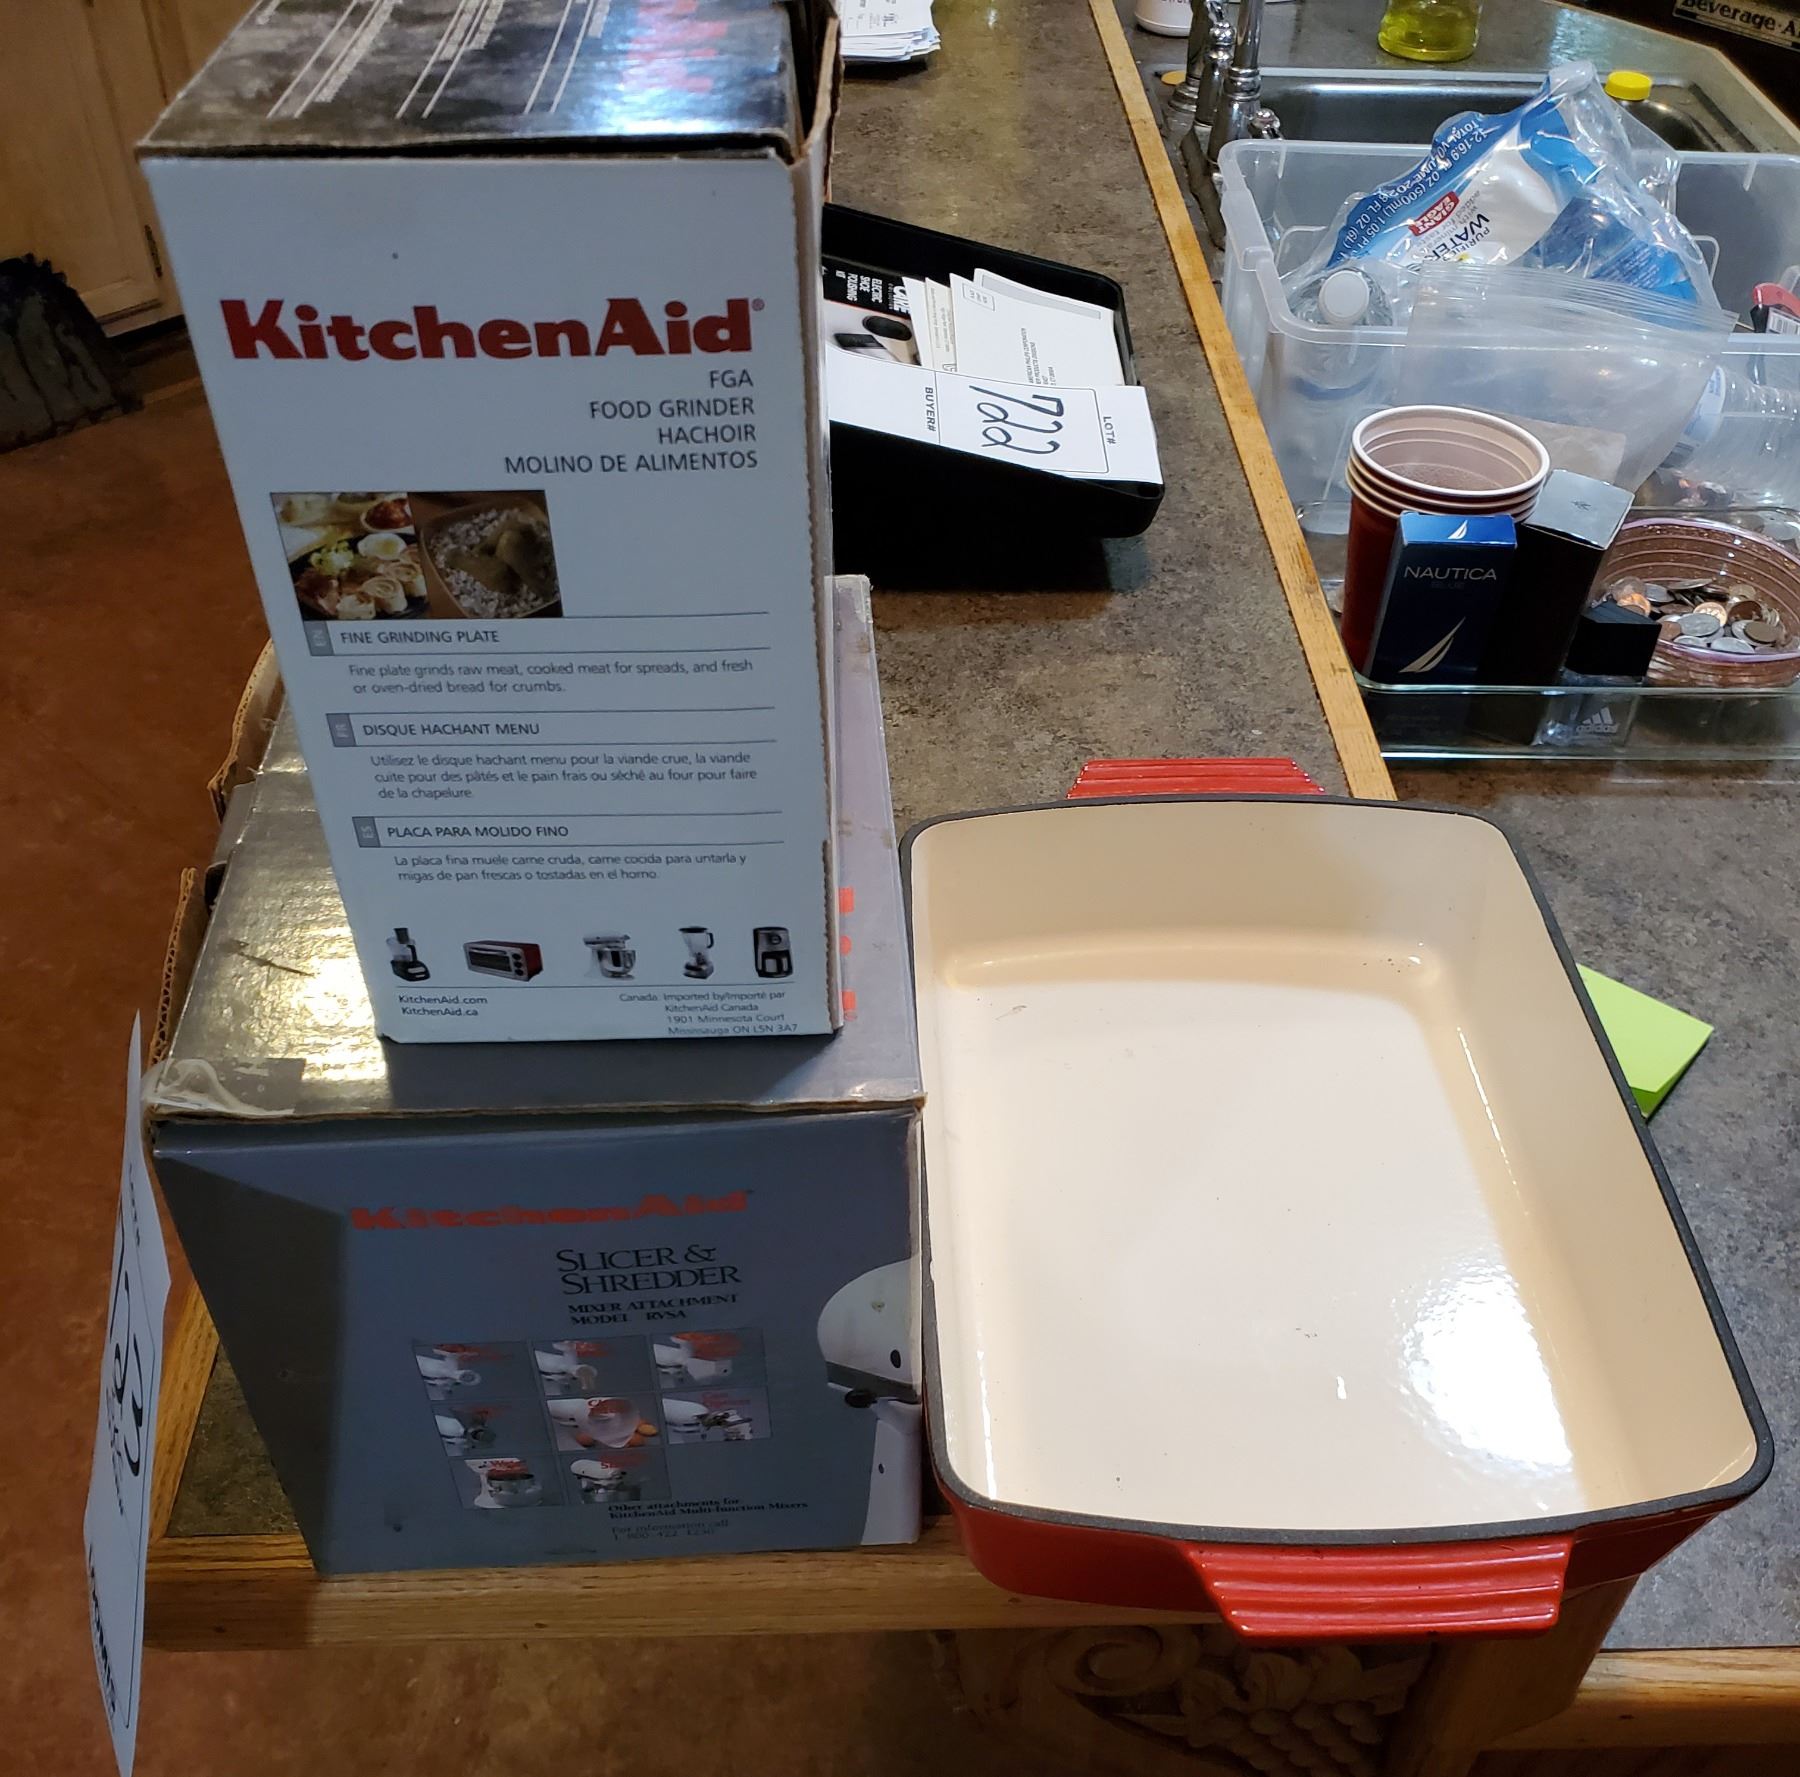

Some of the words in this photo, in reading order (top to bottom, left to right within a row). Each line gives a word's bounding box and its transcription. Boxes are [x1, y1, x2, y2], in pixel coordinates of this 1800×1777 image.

[1452, 129, 1488, 161] 12-16.9
[1428, 173, 1440, 187] OZ
[1366, 200, 1381, 215] FL
[1384, 183, 1427, 218] (500mL)
[1355, 213, 1371, 229] OZ
[1413, 196, 1451, 229] EAGLE
[1416, 200, 1457, 234] GIANT
[1365, 217, 1385, 237] 1.05
[1342, 226, 1360, 249] (6L)
[1424, 213, 1490, 263] WATER
[846, 272, 858, 302] POLISHING
[859, 275, 871, 293] SHOE
[871, 278, 883, 303] ELECTRIC
[219, 297, 753, 361] KitchenAid
[709, 369, 754, 389] FGA
[590, 399, 652, 420] FOOD
[659, 397, 755, 418] GRINDER
[924, 386, 937, 432] BUYER#
[969, 385, 1064, 455] 722
[1102, 415, 1116, 445] LOT#
[658, 424, 757, 445] HACHOIR
[504, 455, 593, 474] MOLINO
[600, 454, 628, 473] DE
[635, 450, 758, 472] ALIMENTOS
[1403, 566, 1497, 581] NAUTICA
[341, 631, 373, 644] FINE
[377, 631, 452, 644] GRINDING
[457, 630, 500, 643] PLATE
[348, 664, 376, 676] Fine
[379, 664, 411, 678] plate
[414, 663, 454, 679] grinds
[458, 665, 482, 676] raw
[486, 664, 524, 677] meat,
[527, 662, 574, 675] cooked
[578, 663, 611, 675] meat
[614, 661, 632, 674] for
[636, 660, 689, 677] spreads,
[693, 660, 718, 673] and
[722, 659, 753, 672] fresh
[353, 683, 367, 694] or
[371, 681, 443, 693] oven-dried
[447, 681, 485, 693] bread
[489, 680, 507, 692] for
[512, 681, 566, 693] crumbs.
[362, 724, 417, 737] DISQUE
[421, 723, 491, 736] HACHANT
[495, 723, 540, 735] MENU
[370, 754, 414, 767] Utilisez
[417, 754, 429, 766] le
[431, 754, 473, 768] disque
[476, 754, 527, 766] hachant
[530, 755, 567, 766] menu
[570, 755, 600, 767] pour
[603, 753, 614, 765] la
[617, 753, 658, 764] viande
[661, 754, 692, 766] crue,
[695, 752, 706, 764] la
[710, 752, 751, 763] viande
[374, 771, 404, 783] cuite
[408, 772, 438, 785] pour
[440, 771, 463, 782] des
[501, 772, 515, 782] et
[517, 769, 529, 781] le
[532, 770, 559, 784] pain
[562, 769, 588, 781] frais
[591, 771, 607, 781] ou
[649, 770, 665, 781] au
[668, 769, 693, 780] four
[697, 769, 727, 782] pour
[730, 767, 758, 780] faire
[378, 787, 395, 799] de
[397, 787, 409, 799] la
[387, 826, 432, 838] PLACA
[435, 826, 472, 837] PARA
[475, 826, 532, 837] MOLIDO
[536, 825, 569, 837] FINO
[394, 855, 408, 866] La
[411, 855, 443, 867] placa
[445, 854, 469, 866] fina
[472, 855, 509, 865] muele
[511, 855, 545, 865] carne
[547, 854, 585, 866] cruda,
[588, 855, 621, 865] carne
[624, 854, 662, 865] cocida
[665, 855, 692, 866] para
[695, 853, 737, 864] untarla
[739, 854, 747, 866] y
[398, 871, 434, 884] migas
[437, 870, 453, 881] de
[455, 871, 479, 883] pan
[481, 870, 522, 881] frescas
[524, 871, 533, 880] o
[536, 870, 586, 881] tostadas
[589, 870, 604, 880] en
[607, 868, 617, 880] el
[398, 994, 488, 1004] KitchenAid.com
[769, 992, 785, 1002] par
[401, 1007, 478, 1016] KitchenAid.ca
[665, 1003, 719, 1012] KitchenAid
[721, 1003, 759, 1012] Canada
[667, 1015, 693, 1024] 1901
[697, 1014, 753, 1024] Minnesota
[756, 1014, 785, 1023] Court
[732, 1025, 750, 1034] ON
[350, 1190, 748, 1231] KitchenAid
[556, 1247, 679, 1273] SLICER
[684, 1244, 717, 1263] &
[561, 1265, 743, 1295] SHREDDER
[568, 1303, 622, 1314] MIXER
[627, 1294, 740, 1311] ATTACHMENT
[570, 1313, 629, 1326] MODEL
[646, 1310, 688, 1321] RVSA
